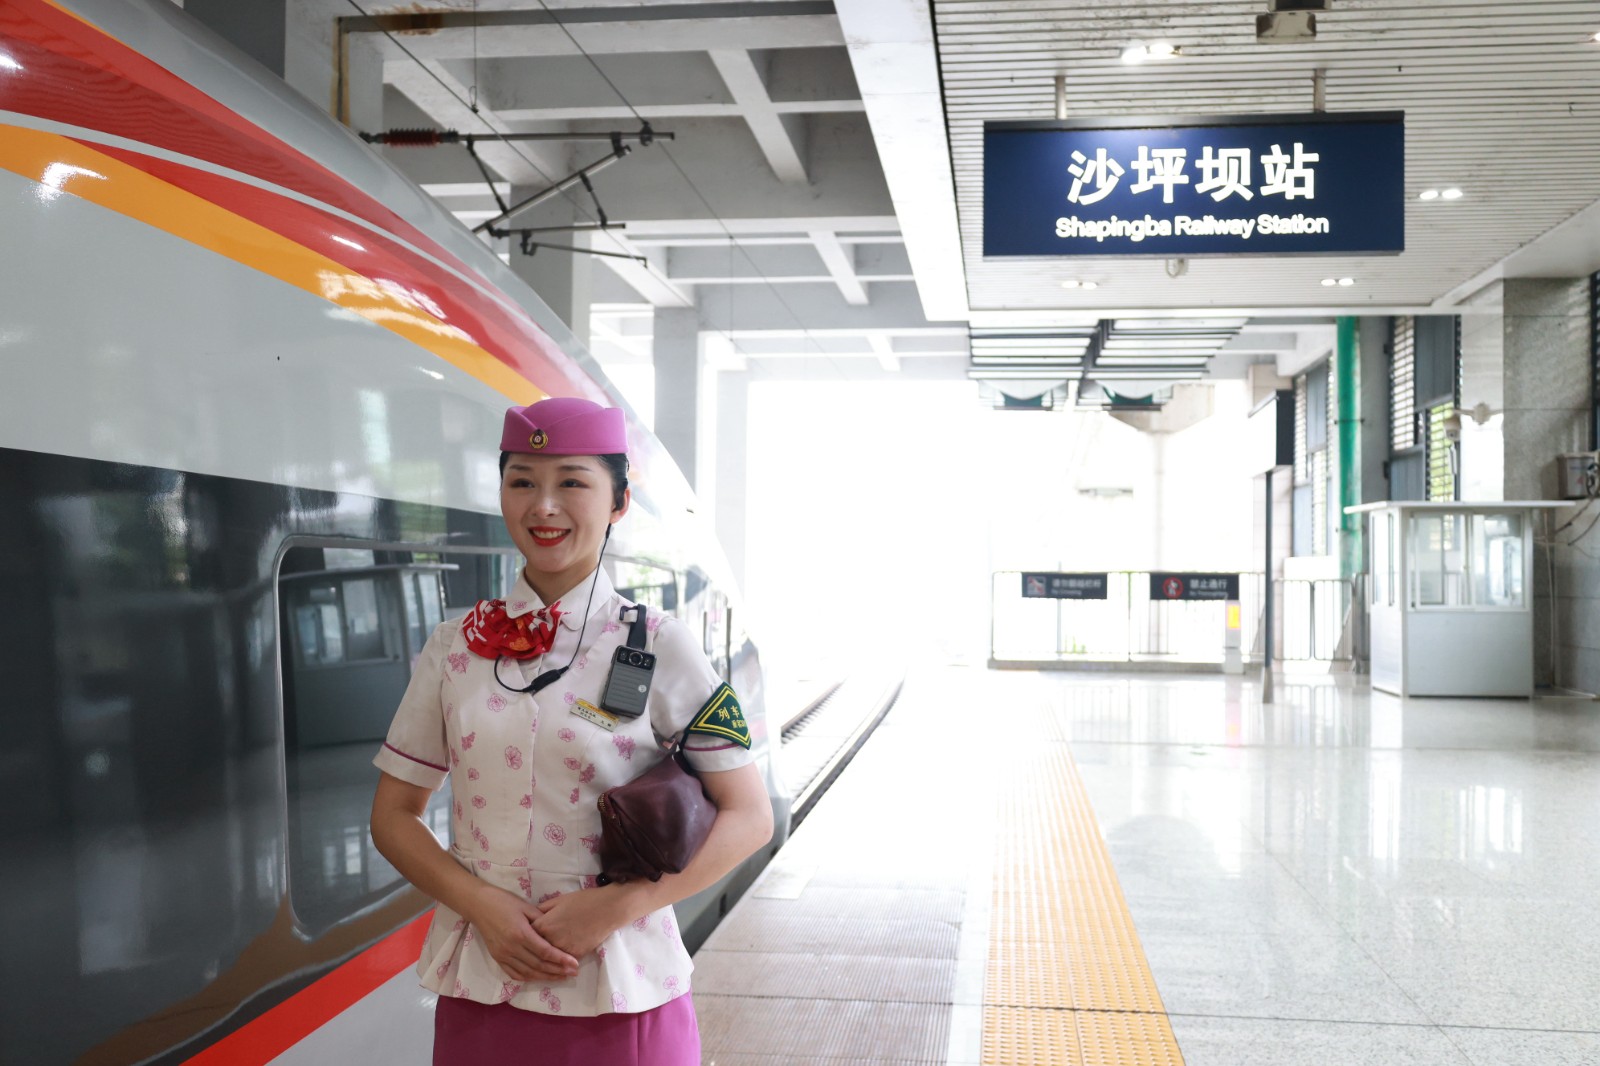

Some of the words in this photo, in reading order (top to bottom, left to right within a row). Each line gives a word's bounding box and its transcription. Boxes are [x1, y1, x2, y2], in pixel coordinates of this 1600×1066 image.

[1067, 142, 1320, 205] 沙坪坝站
[1055, 214, 1171, 242] Shapingba
[1174, 213, 1255, 239] Railway
[1256, 211, 1330, 236] Station
